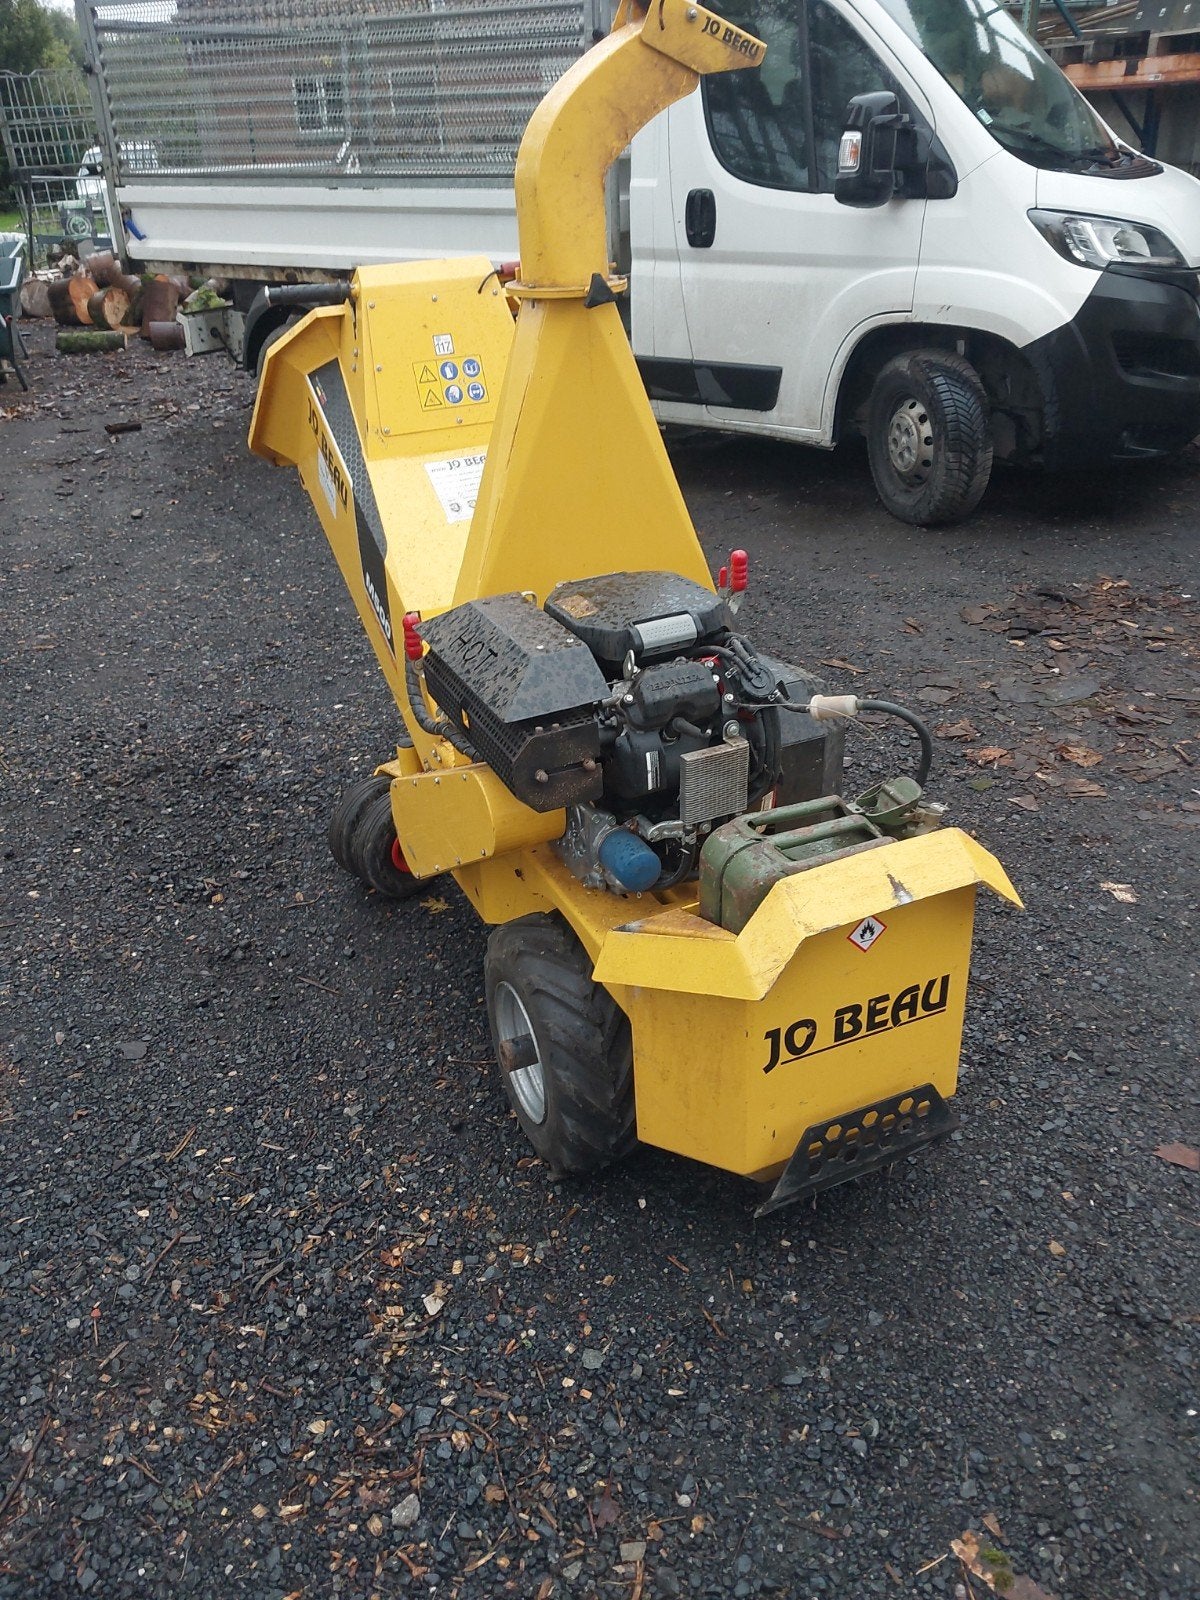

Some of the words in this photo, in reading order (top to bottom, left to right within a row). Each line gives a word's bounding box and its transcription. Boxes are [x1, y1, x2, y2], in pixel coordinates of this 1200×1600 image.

[701, 16, 721, 35] JO
[722, 27, 760, 59] BEAU
[435, 341, 451, 353] 117
[306, 397, 319, 436] JO
[321, 431, 348, 507] BEAU
[447, 459, 461, 471] JO
[463, 455, 487, 467] BEA
[449, 627, 498, 671] HOT
[762, 1018, 818, 1075] JO
[833, 973, 951, 1044] BEAU
